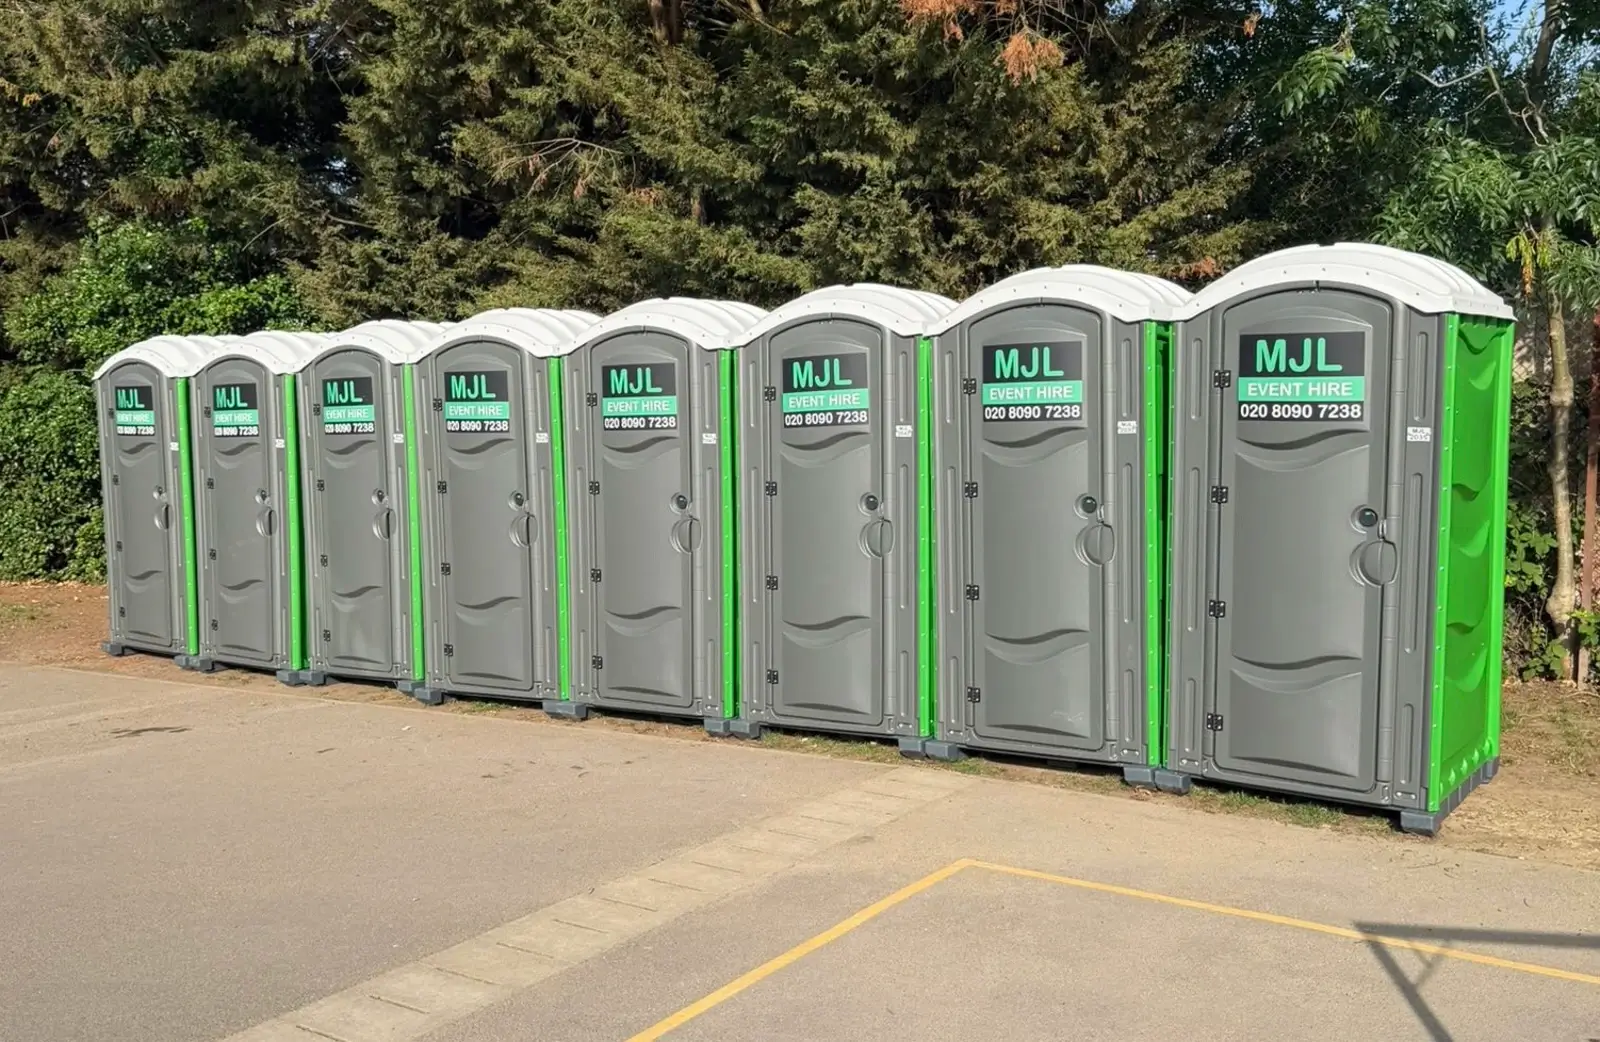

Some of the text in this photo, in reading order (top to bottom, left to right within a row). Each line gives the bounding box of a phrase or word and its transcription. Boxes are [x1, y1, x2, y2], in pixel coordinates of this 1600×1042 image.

[995, 346, 1064, 379] MJL
[1256, 337, 1343, 373] MJL
[610, 367, 663, 394] MJL
[792, 358, 852, 388] MJL
[327, 380, 363, 404] MJL
[451, 374, 496, 399] MJL
[990, 385, 1073, 400] EVENT HIRE
[1247, 382, 1353, 397] EVENT HIRE
[117, 388, 145, 408] MJL
[216, 387, 248, 408] MJL
[788, 393, 861, 408] EVENT HIRE
[449, 405, 502, 416] EVENT HIRE
[607, 400, 670, 412] EVENT HIRE
[984, 405, 1080, 420] 020 8090 7238
[1240, 404, 1362, 418] 020 8090 7238
[326, 409, 369, 419] EVENT HIRE
[785, 411, 868, 426] 020 8090 7238
[352, 422, 374, 433] 7238
[447, 420, 508, 431] 020 8090 7238
[604, 416, 676, 428] 020 8090 7238
[239, 426, 258, 435] 7238
